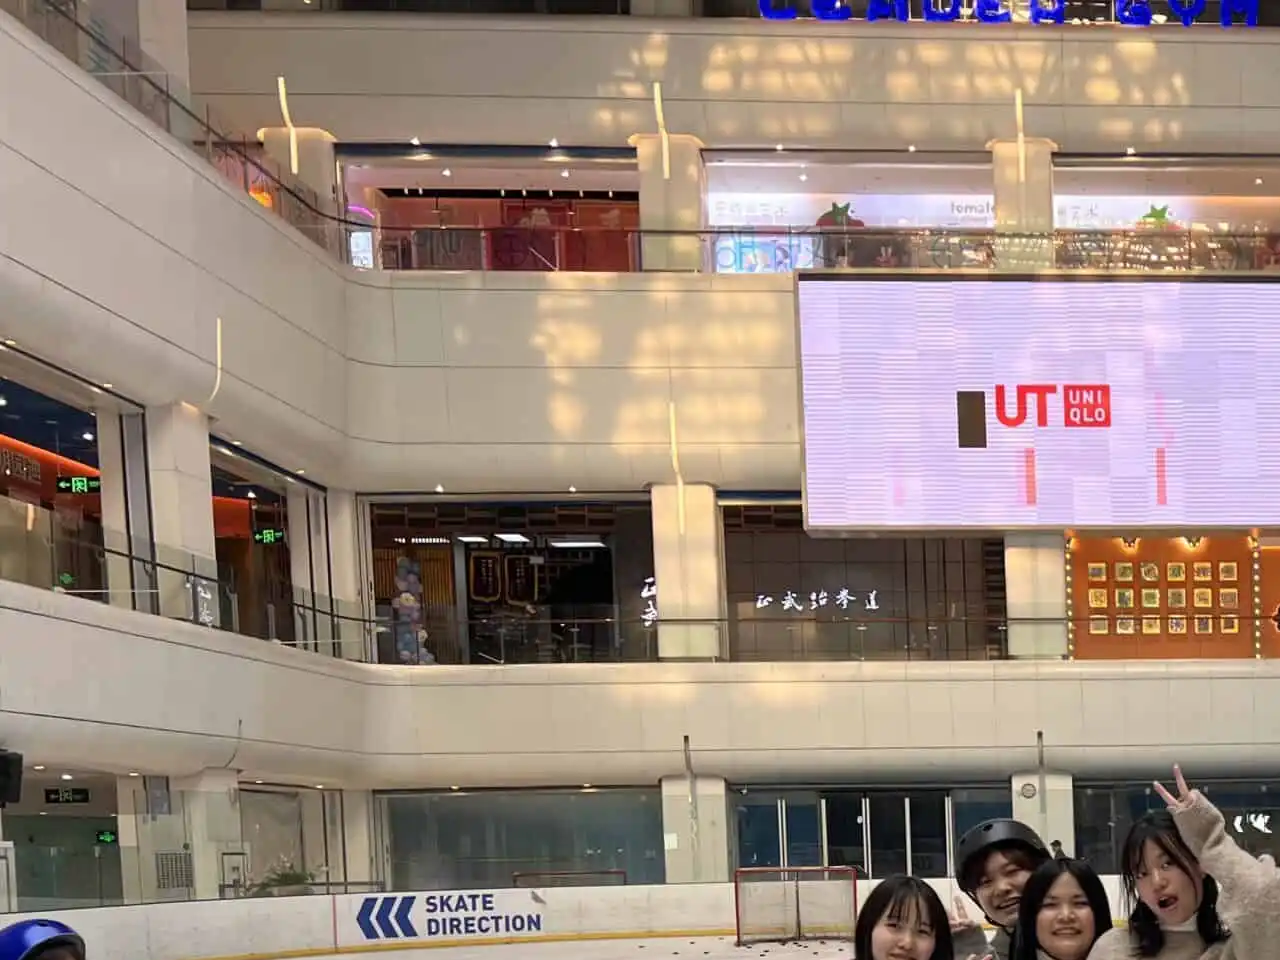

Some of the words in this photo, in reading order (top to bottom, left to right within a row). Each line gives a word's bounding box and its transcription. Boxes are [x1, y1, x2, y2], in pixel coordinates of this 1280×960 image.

[995, 384, 1057, 427] UT
[1069, 389, 1103, 405] UNI
[1069, 407, 1106, 424] QLO
[425, 894, 494, 913] SKATE
[427, 914, 541, 936] DIRECTION
